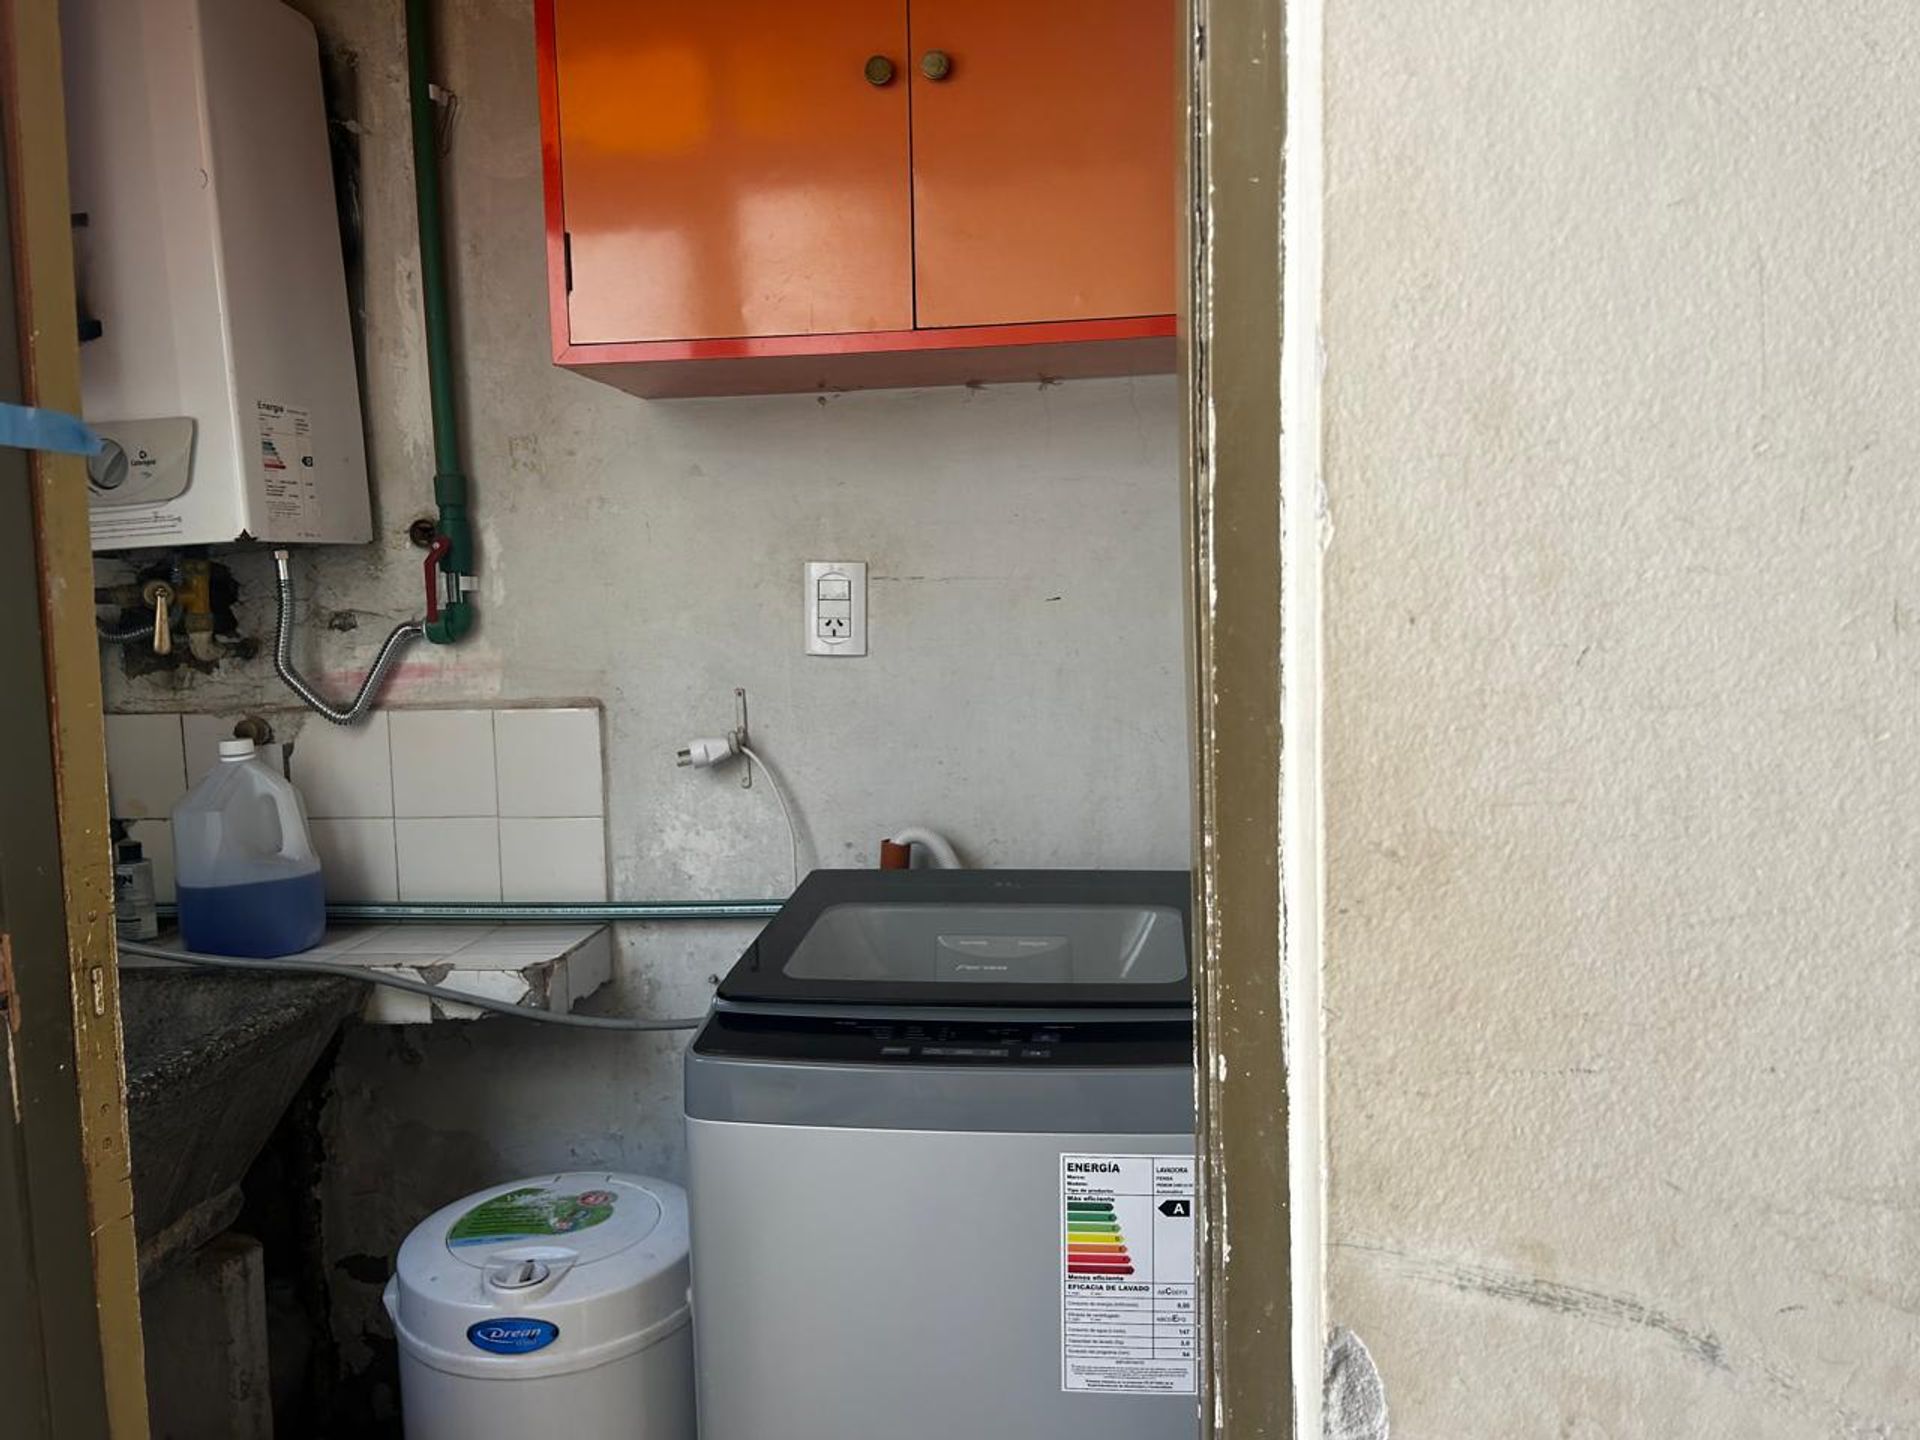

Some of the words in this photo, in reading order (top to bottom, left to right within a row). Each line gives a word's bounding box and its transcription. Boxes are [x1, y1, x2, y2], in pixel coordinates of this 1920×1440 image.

[1067, 1161, 1120, 1173] ENERGÍA
[1173, 1203, 1185, 1214] A
[488, 1327, 542, 1338] Drean
